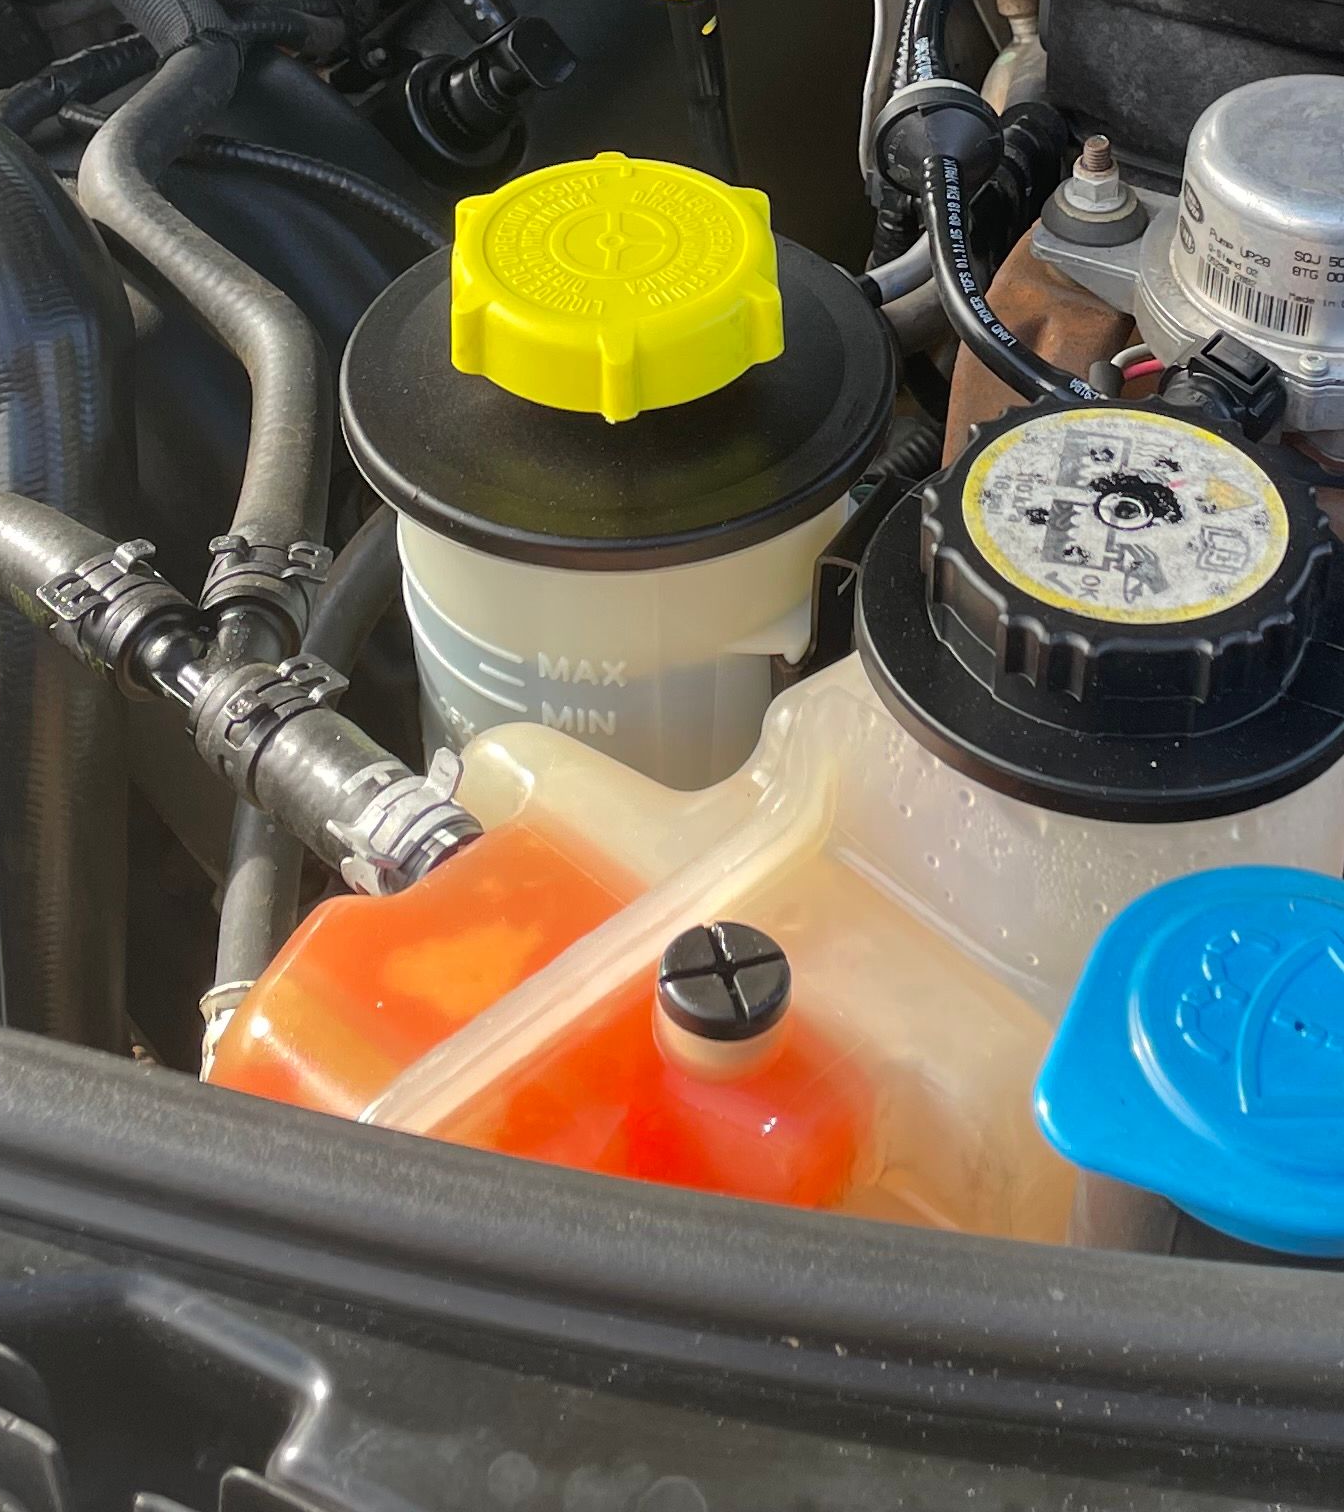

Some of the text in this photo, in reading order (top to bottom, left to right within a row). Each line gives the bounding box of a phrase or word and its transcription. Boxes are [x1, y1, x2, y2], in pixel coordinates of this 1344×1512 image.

[1240, 245, 1271, 268] UP28
[1293, 249, 1322, 265] SQJ
[537, 650, 630, 689] MAX
[540, 700, 619, 738] MIN
